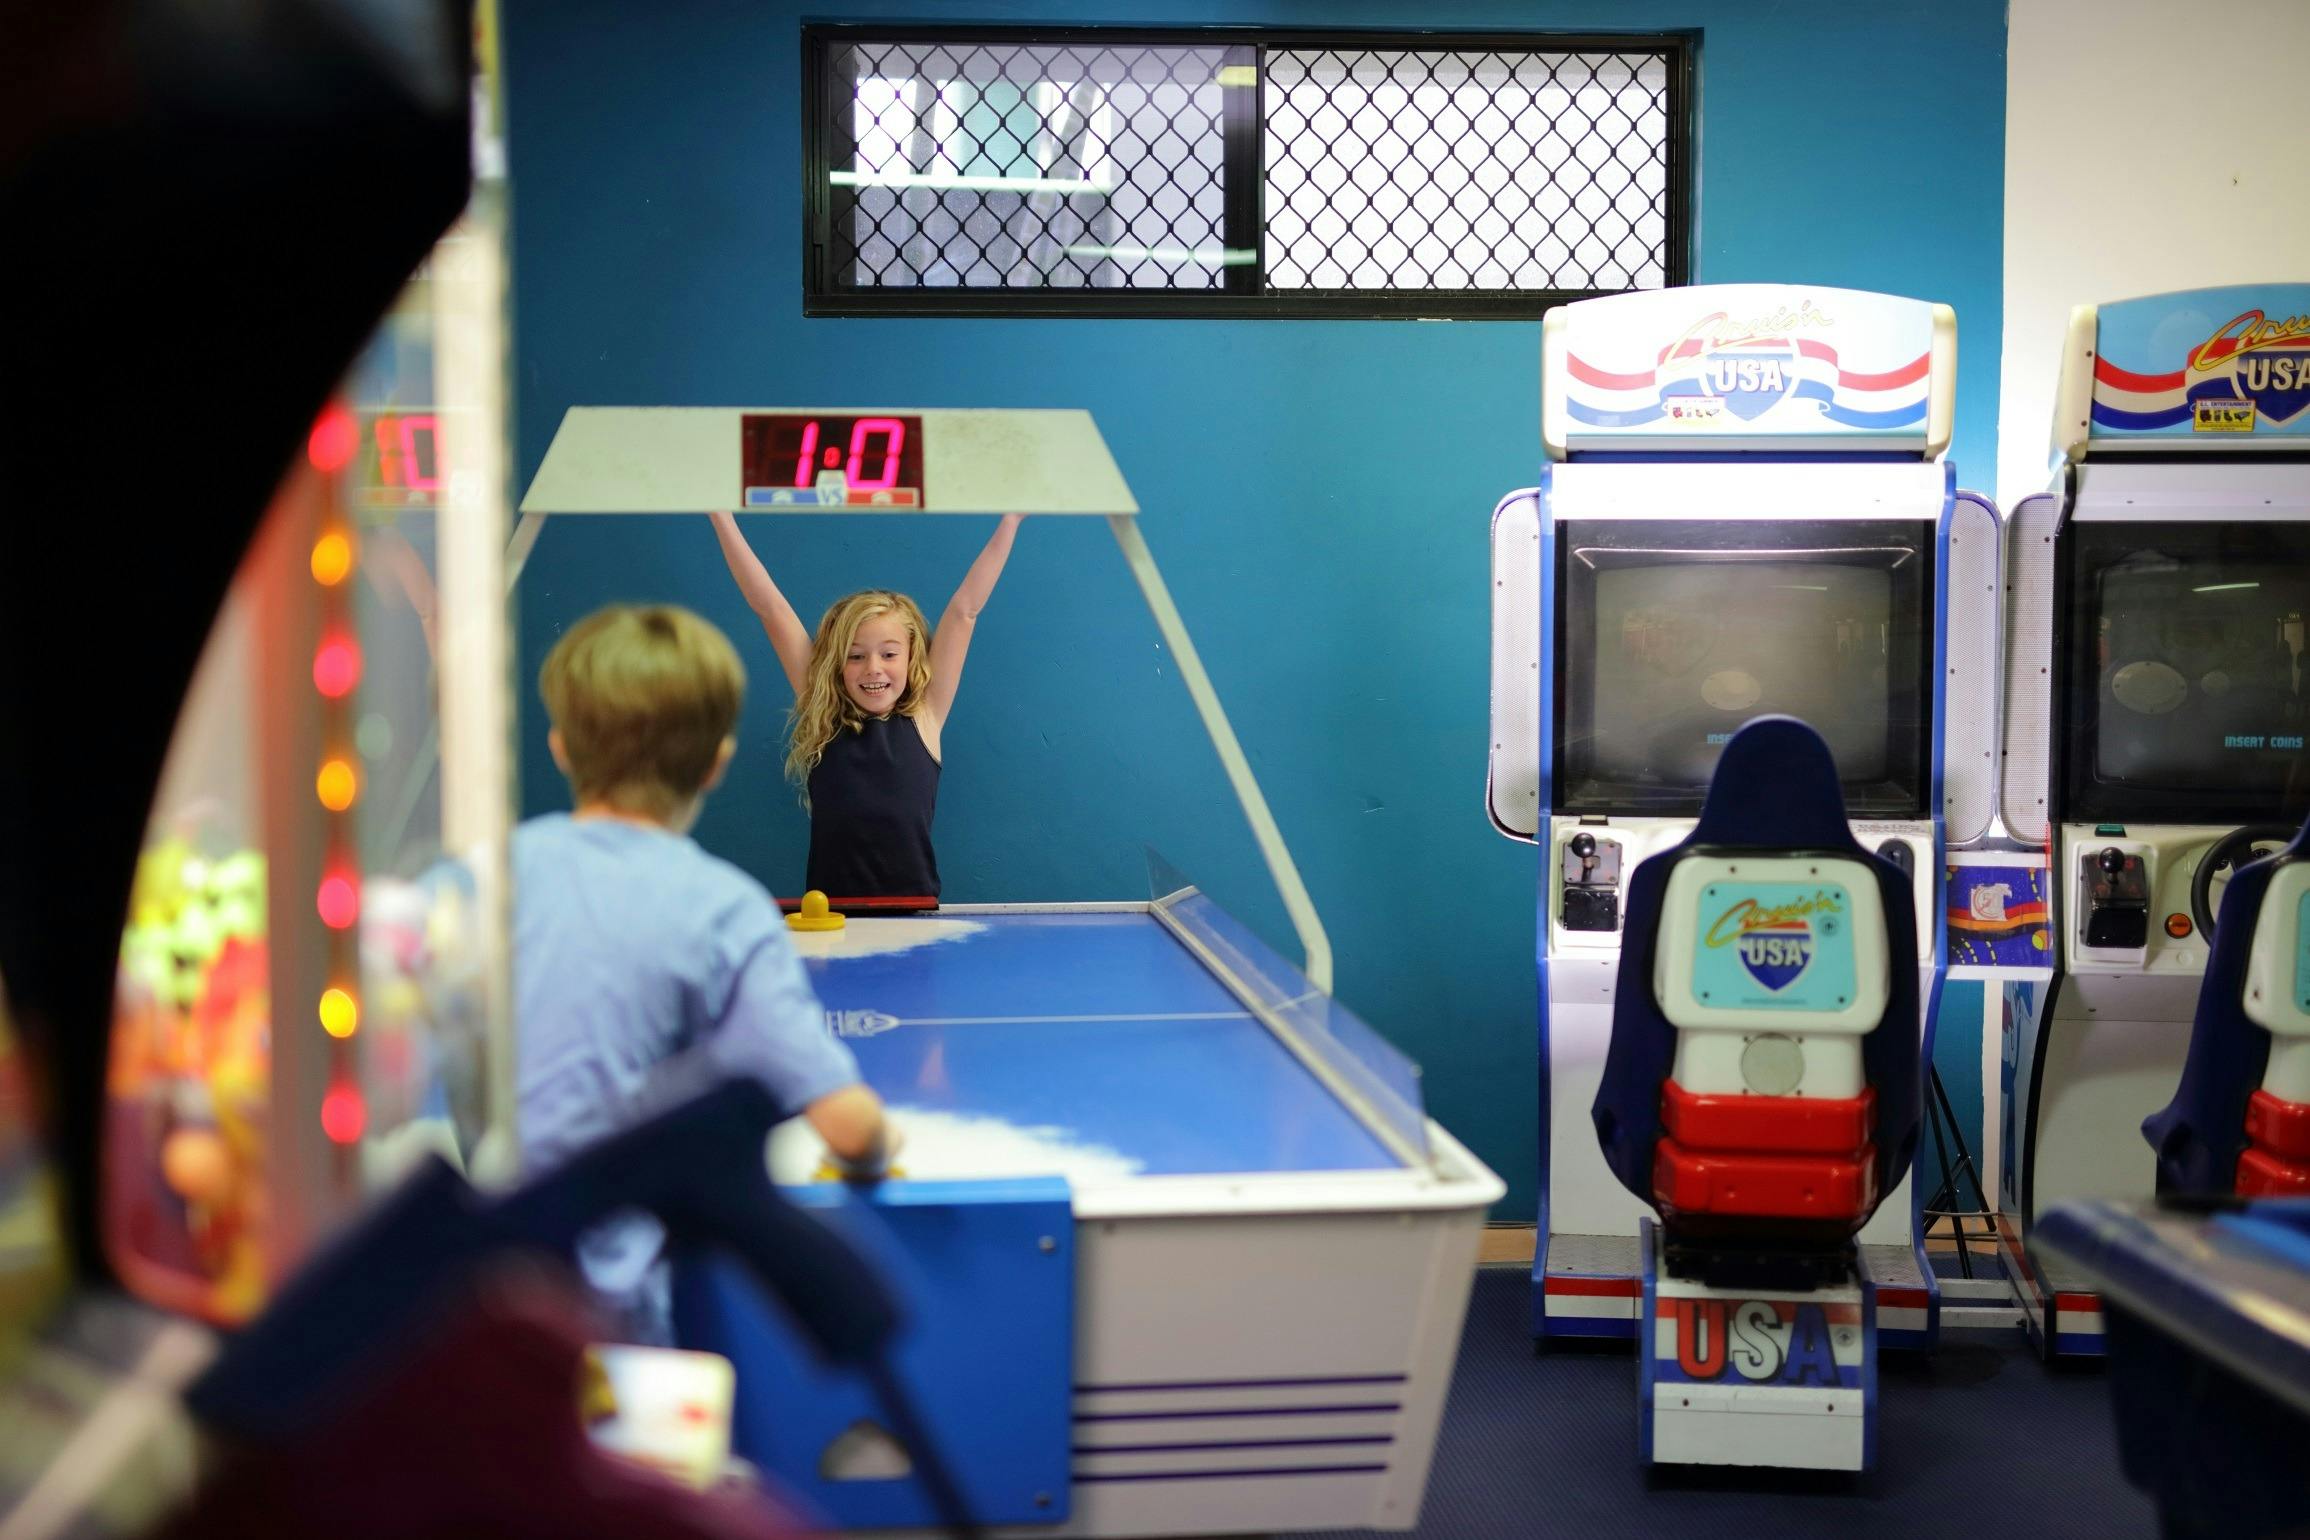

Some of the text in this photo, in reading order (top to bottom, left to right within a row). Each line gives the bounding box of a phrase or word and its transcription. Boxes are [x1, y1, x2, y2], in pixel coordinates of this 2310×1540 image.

[1714, 358, 1785, 394] USA
[2224, 735, 2304, 748] INSERT COINS
[1747, 938, 1804, 967] USA
[1676, 1299, 1842, 1387] USA
